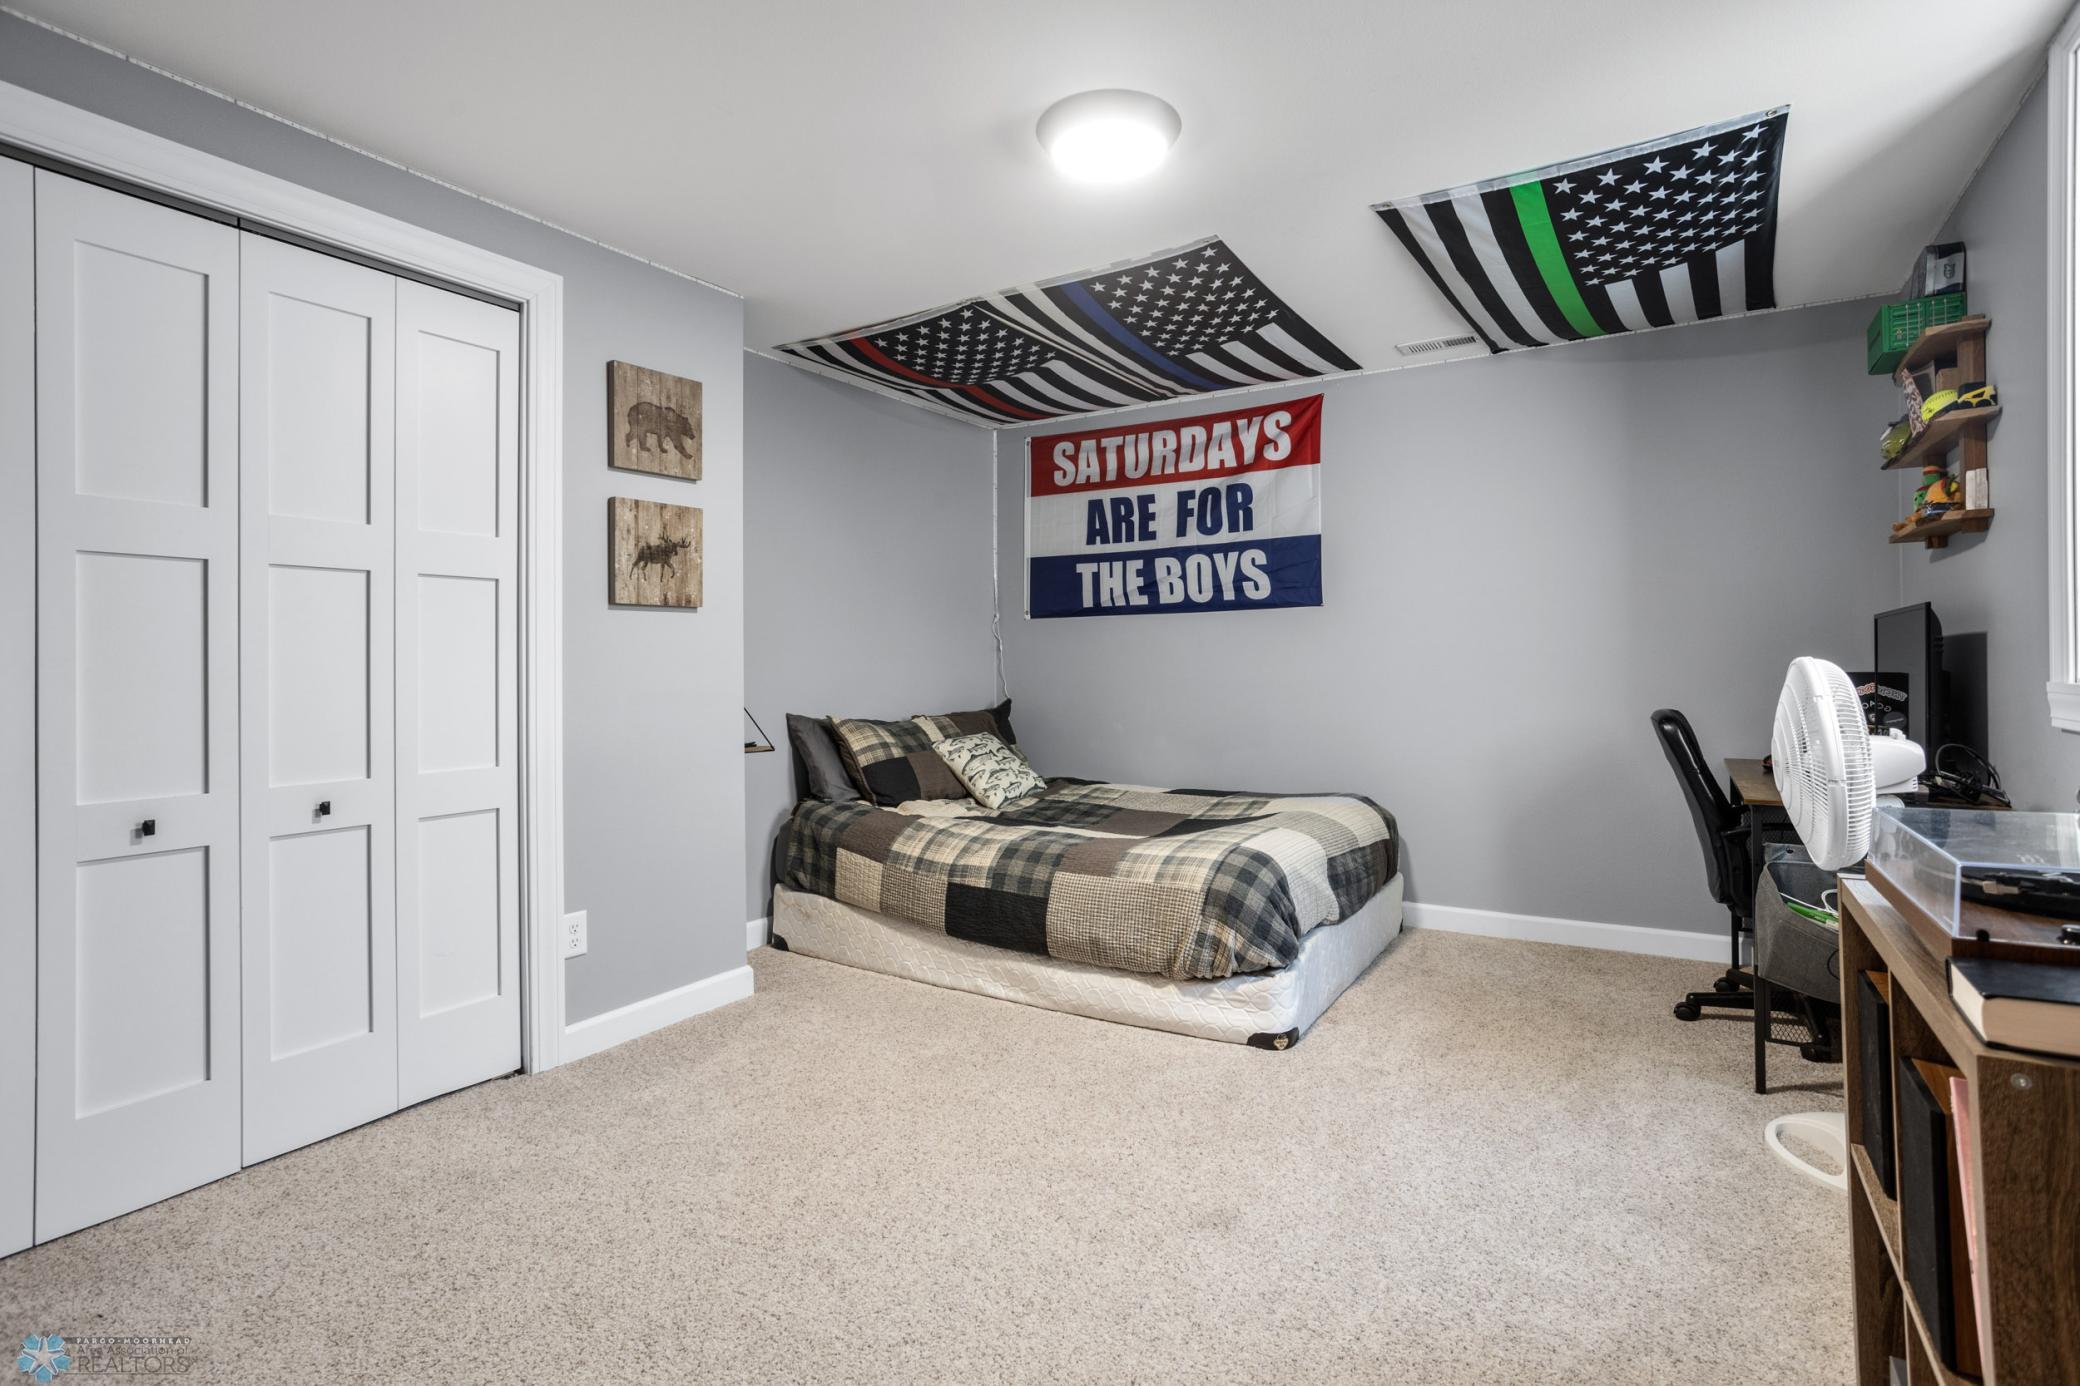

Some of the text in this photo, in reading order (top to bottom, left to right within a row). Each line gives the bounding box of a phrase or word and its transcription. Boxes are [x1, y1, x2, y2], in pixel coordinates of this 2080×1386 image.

[1053, 410, 1292, 487] SATURDAYS
[1086, 482, 1254, 546] ARE FOR
[1076, 548, 1272, 609] THE BOYS
